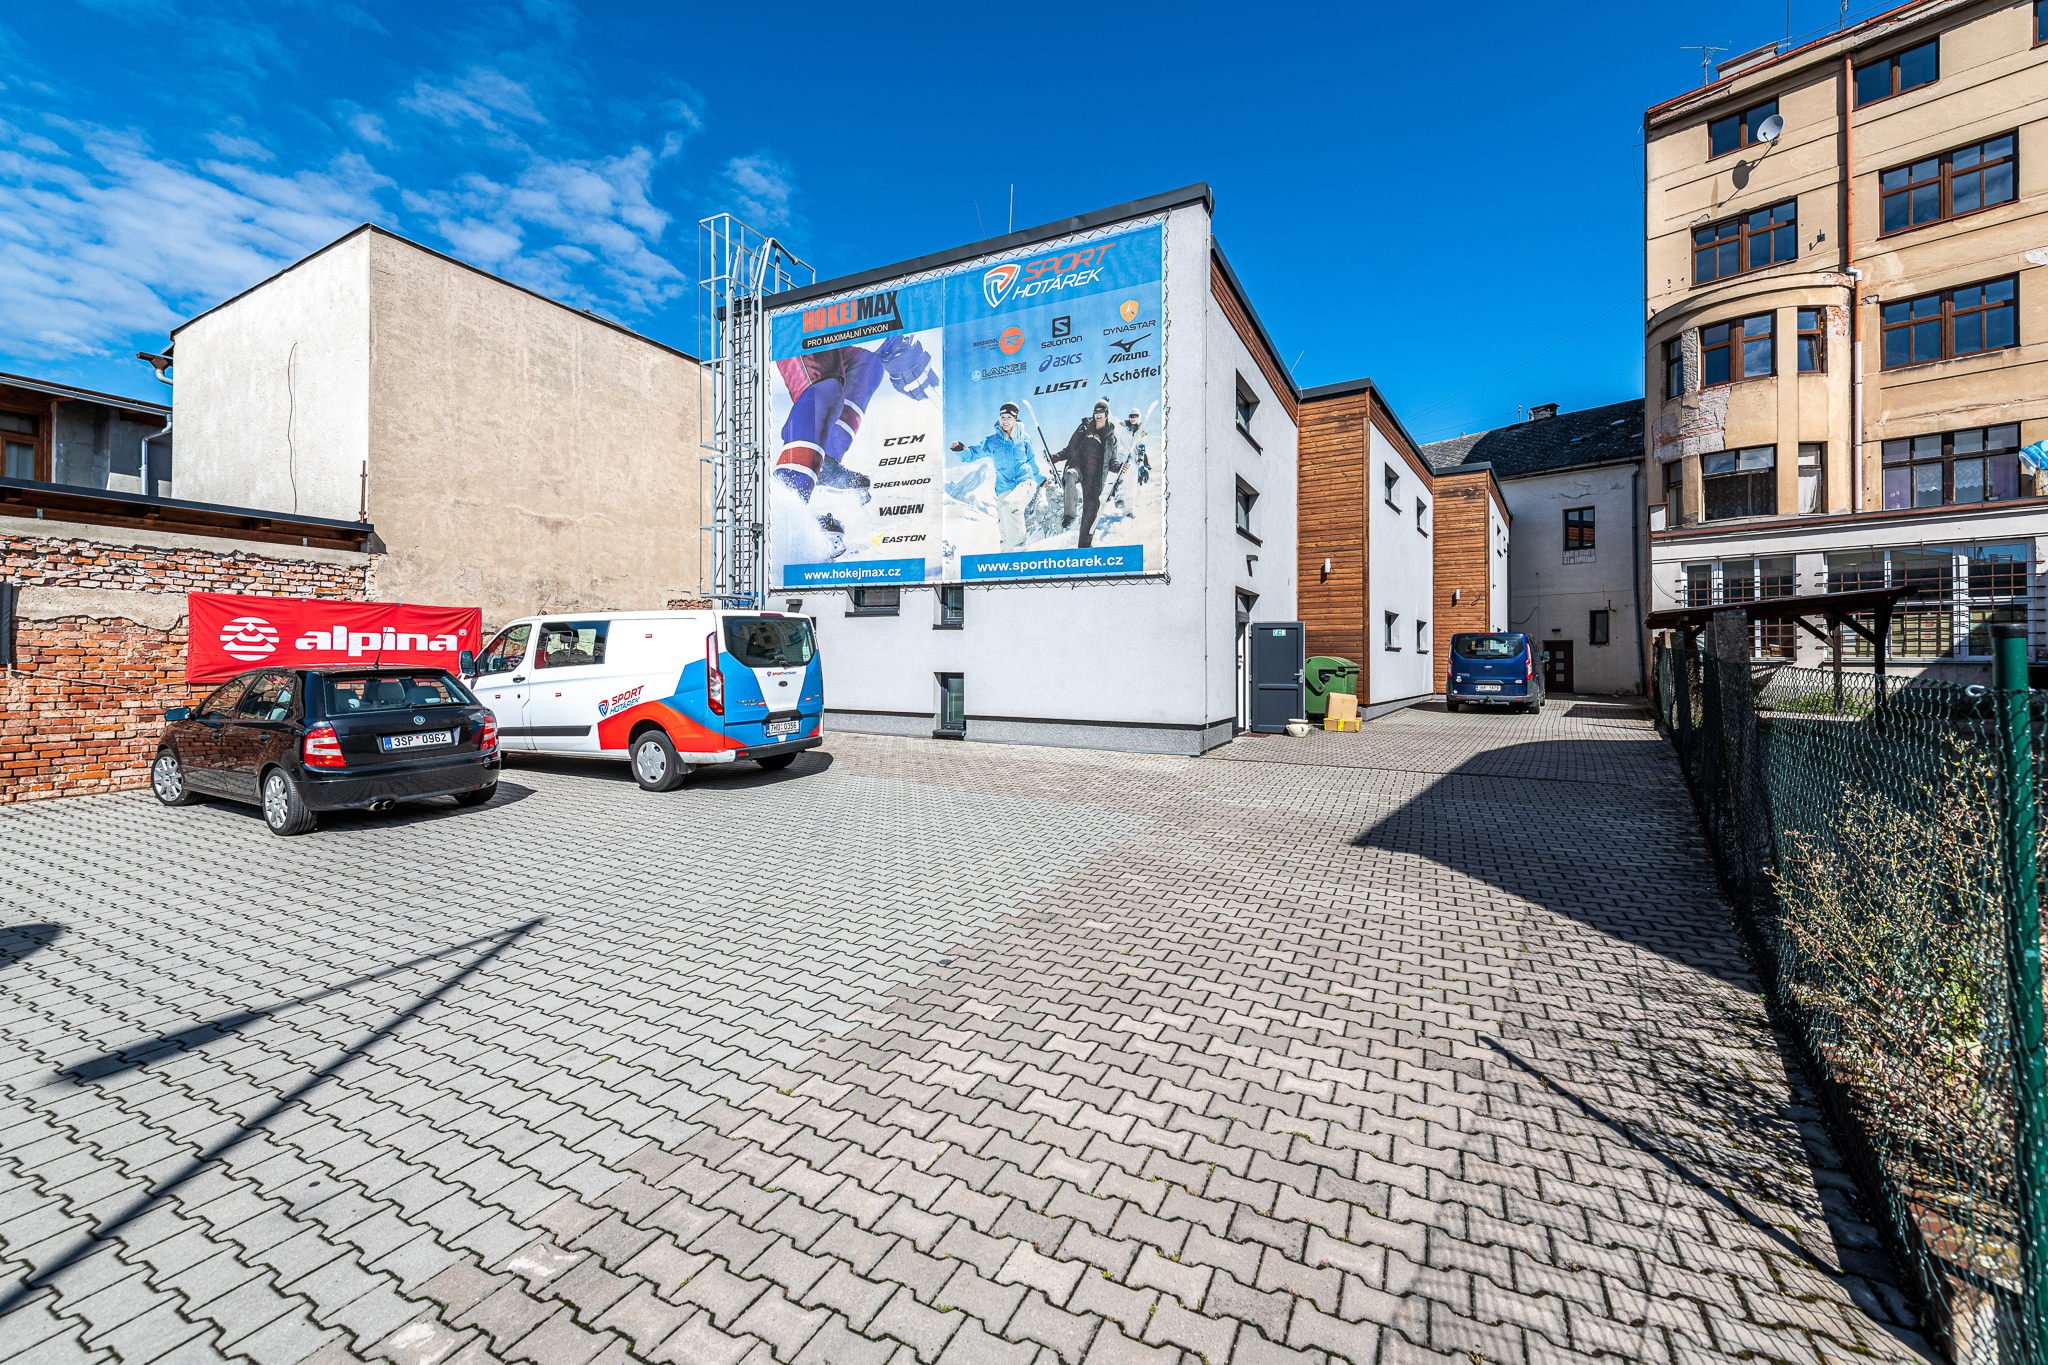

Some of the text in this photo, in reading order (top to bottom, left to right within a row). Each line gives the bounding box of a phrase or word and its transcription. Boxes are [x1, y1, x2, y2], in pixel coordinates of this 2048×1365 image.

[1021, 243, 1116, 282] SPORT
[1012, 267, 1104, 300] HOTÁREK
[803, 290, 903, 333] HOKEJMAX
[807, 323, 889, 348] PRO MAXIMÁLNÍ VÝKON
[1103, 320, 1156, 336] DYNASTAR
[982, 362, 1026, 378] LANGE
[1112, 365, 1161, 382] Schöffel
[884, 434, 925, 447] CCM
[879, 504, 925, 516] VAUGHN
[882, 534, 926, 544] EASTON
[977, 555, 1124, 573] www.sporthotarek.cz
[804, 568, 901, 580] www.hokejmax.cz
[295, 625, 457, 657] alpina
[611, 685, 644, 706] SPORT
[610, 697, 641, 715] HOTÁREK
[394, 733, 447, 747] 3SP 0962
